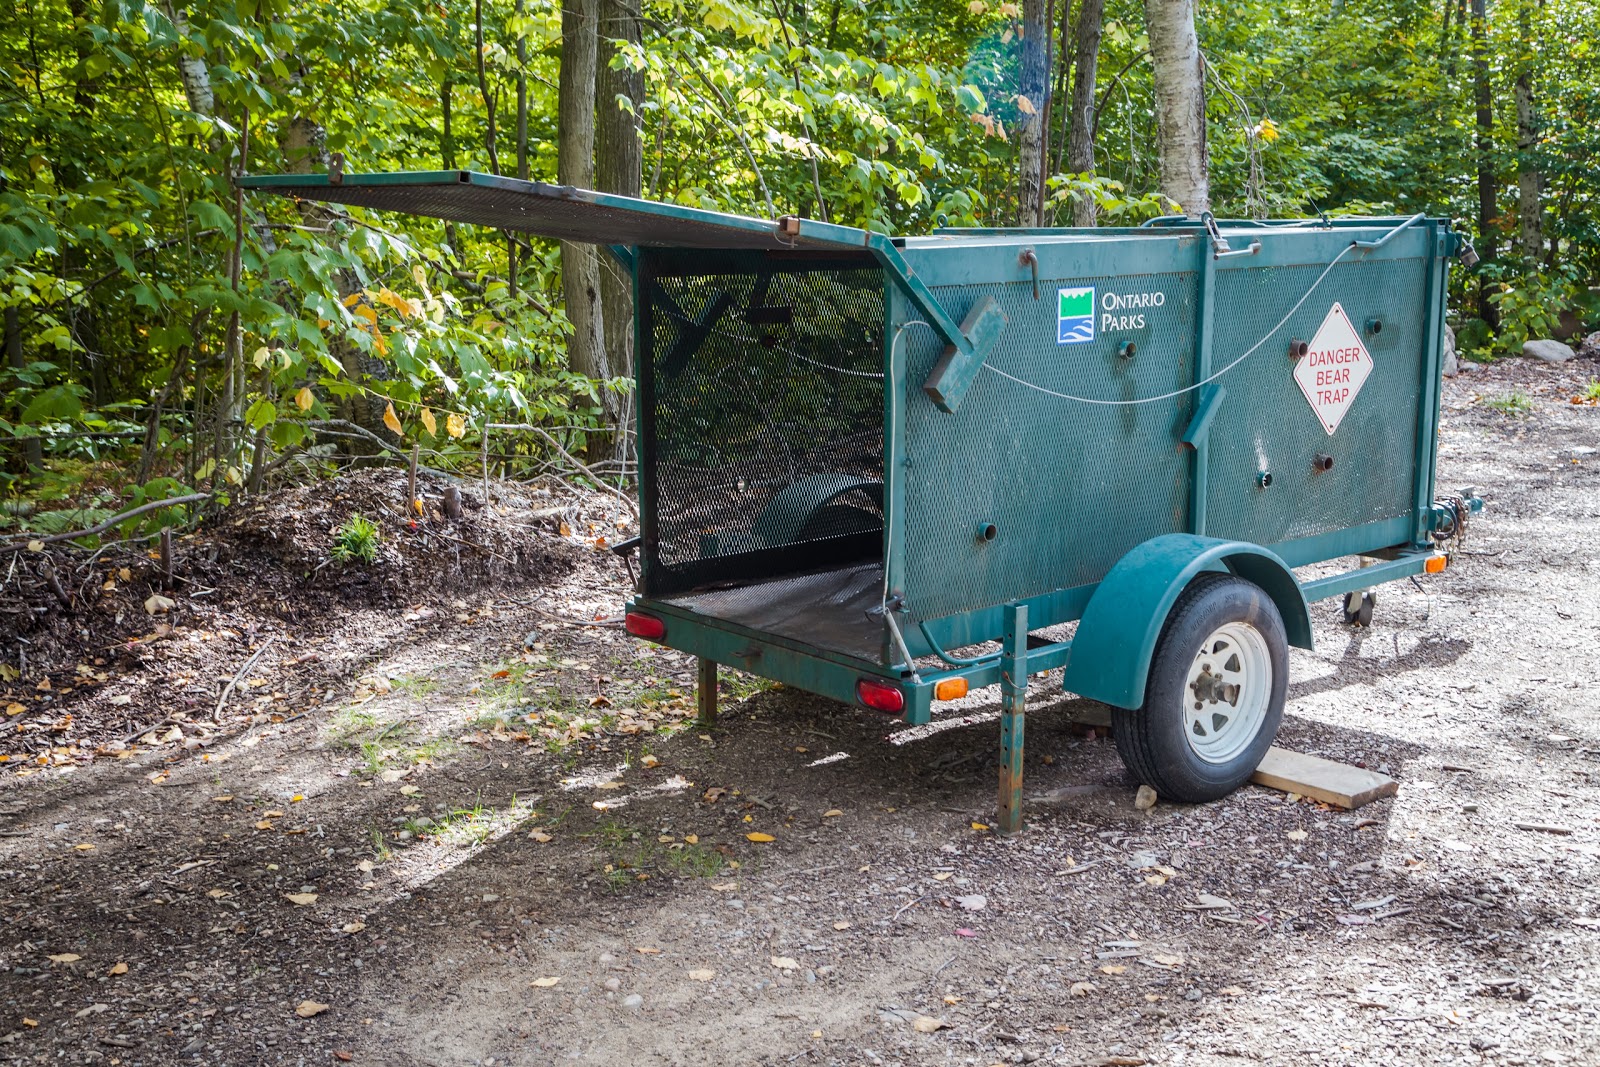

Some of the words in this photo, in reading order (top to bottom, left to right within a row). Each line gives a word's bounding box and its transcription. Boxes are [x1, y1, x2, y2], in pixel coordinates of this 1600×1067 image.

[1309, 347, 1360, 367] DANGER
[1316, 368, 1350, 386] BEAR
[1316, 388, 1349, 406] TRAP
